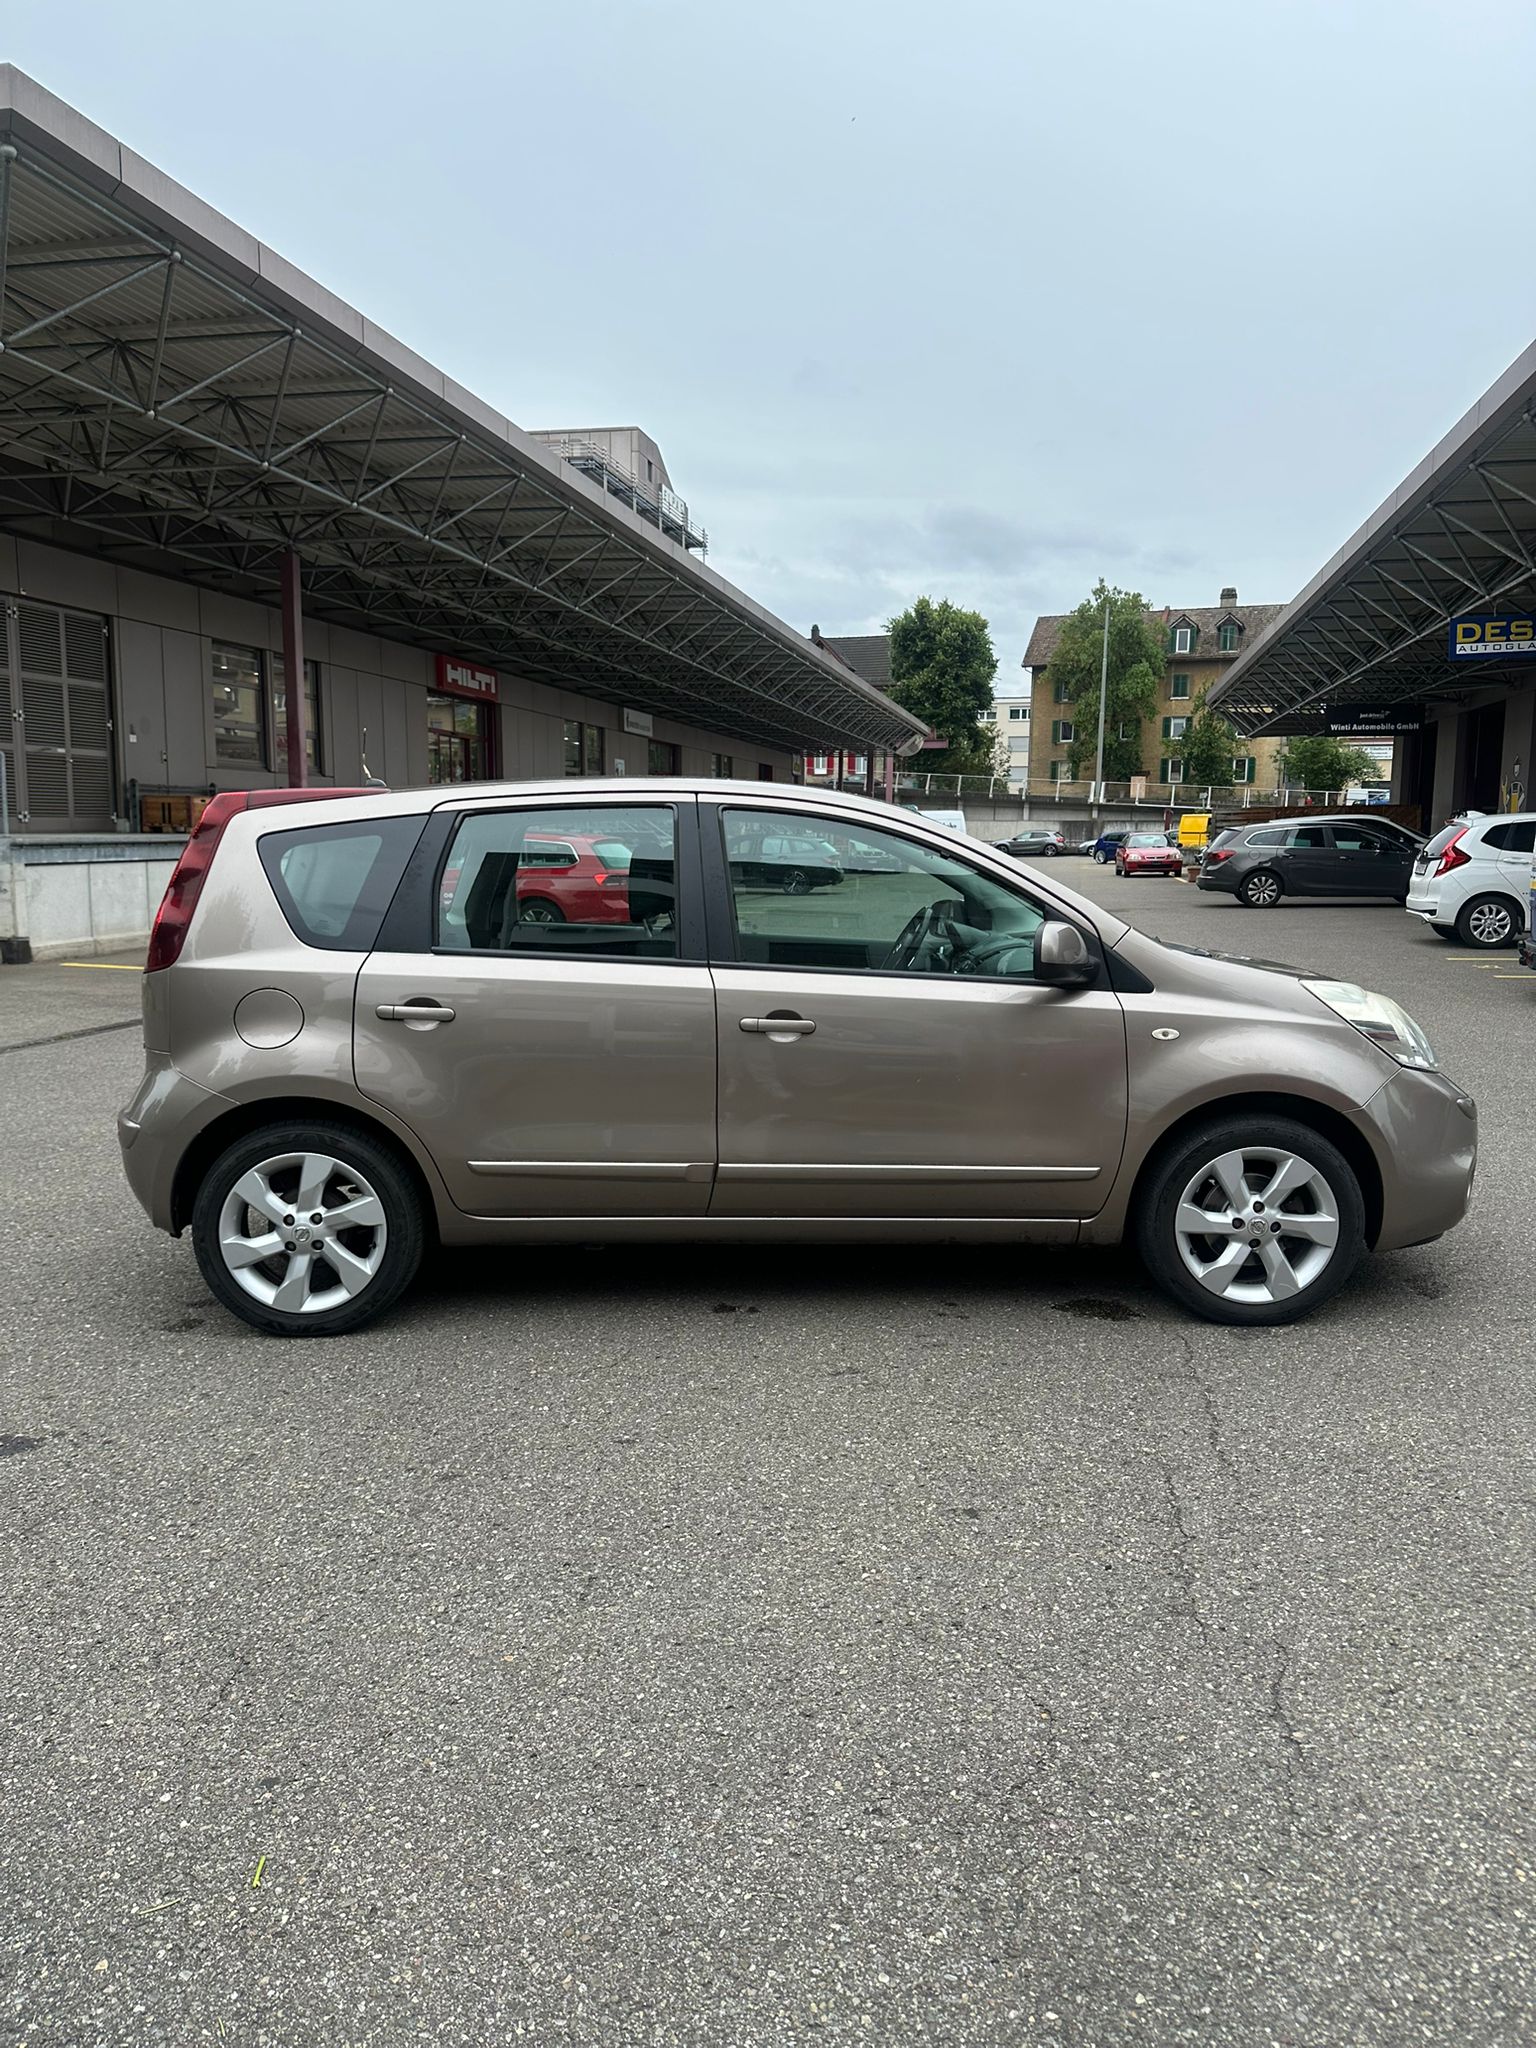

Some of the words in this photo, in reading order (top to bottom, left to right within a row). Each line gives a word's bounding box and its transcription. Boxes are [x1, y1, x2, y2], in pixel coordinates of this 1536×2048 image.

[1456, 620, 1536, 643] DES
[1458, 642, 1536, 653] AUTOGLA
[446, 663, 496, 694] HILTI
[1330, 723, 1351, 731] Winti
[1352, 722, 1395, 731] Automobile
[1396, 722, 1420, 730] GmbH
